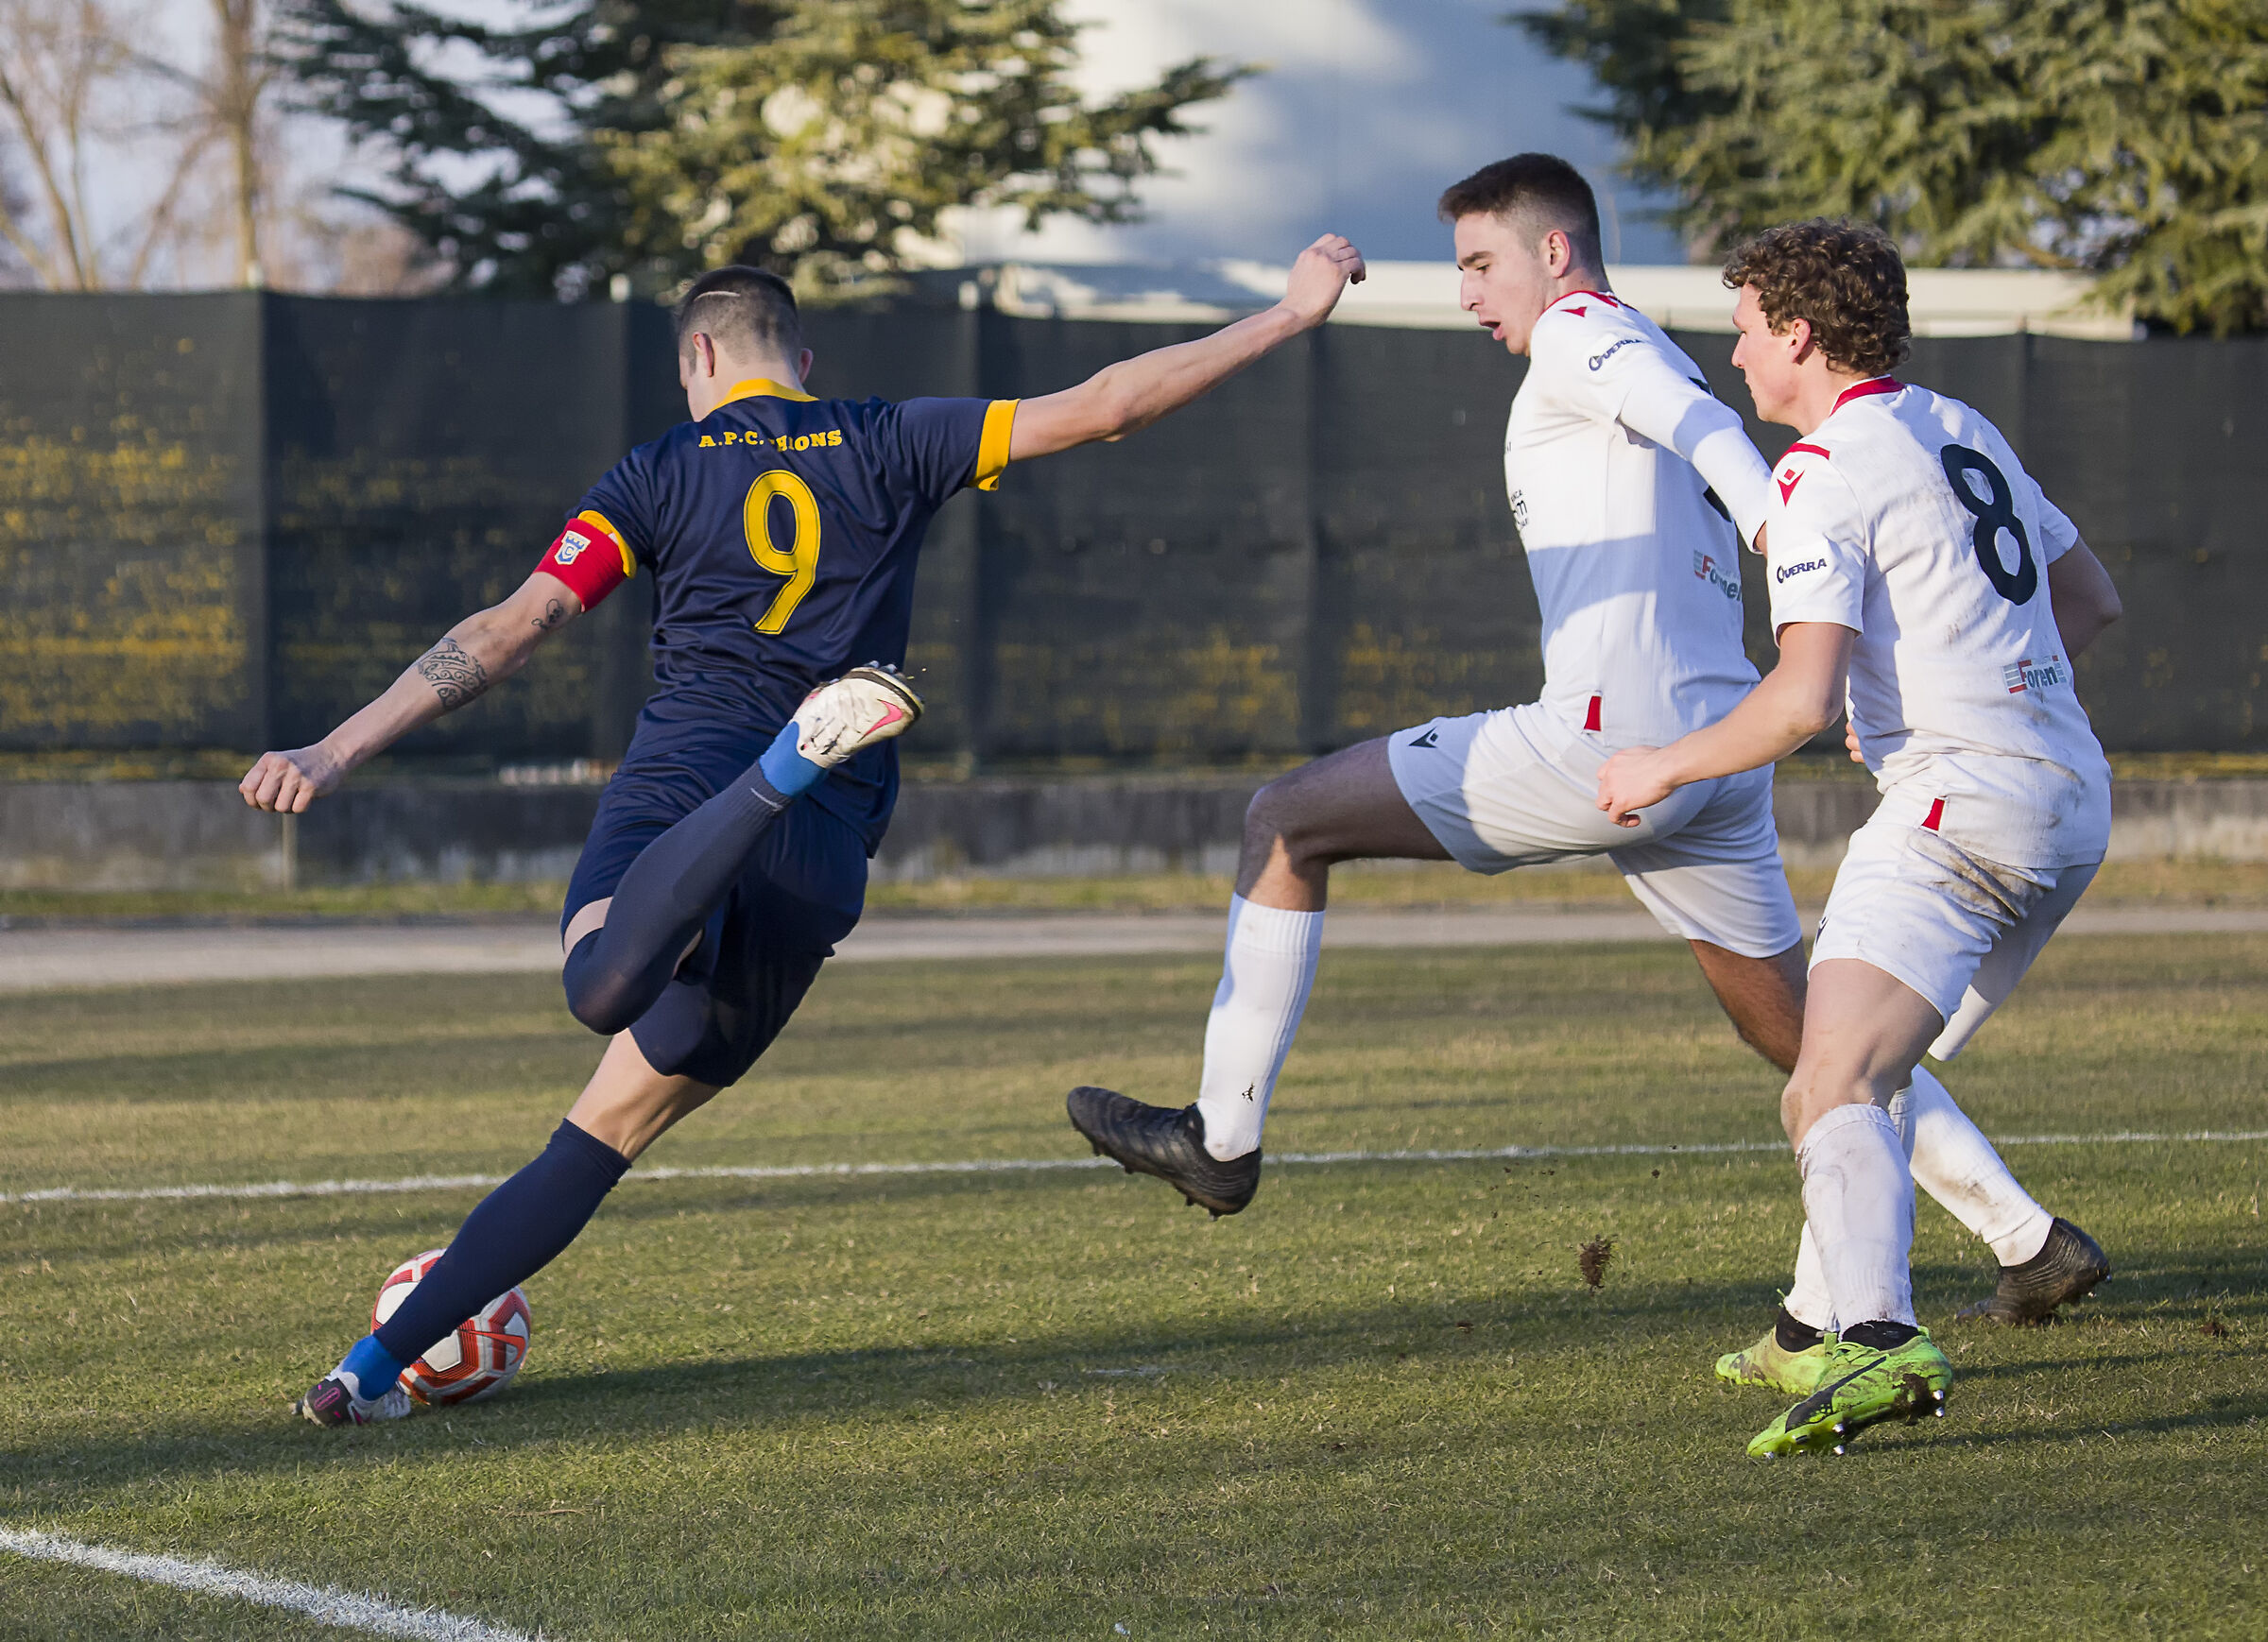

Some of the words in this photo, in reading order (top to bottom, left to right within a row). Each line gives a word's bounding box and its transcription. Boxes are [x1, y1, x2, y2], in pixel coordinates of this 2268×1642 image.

[698, 431, 764, 448] A.P.C.
[767, 429, 843, 453] HIONS
[744, 470, 821, 635] 9
[1940, 444, 2037, 606] 8
